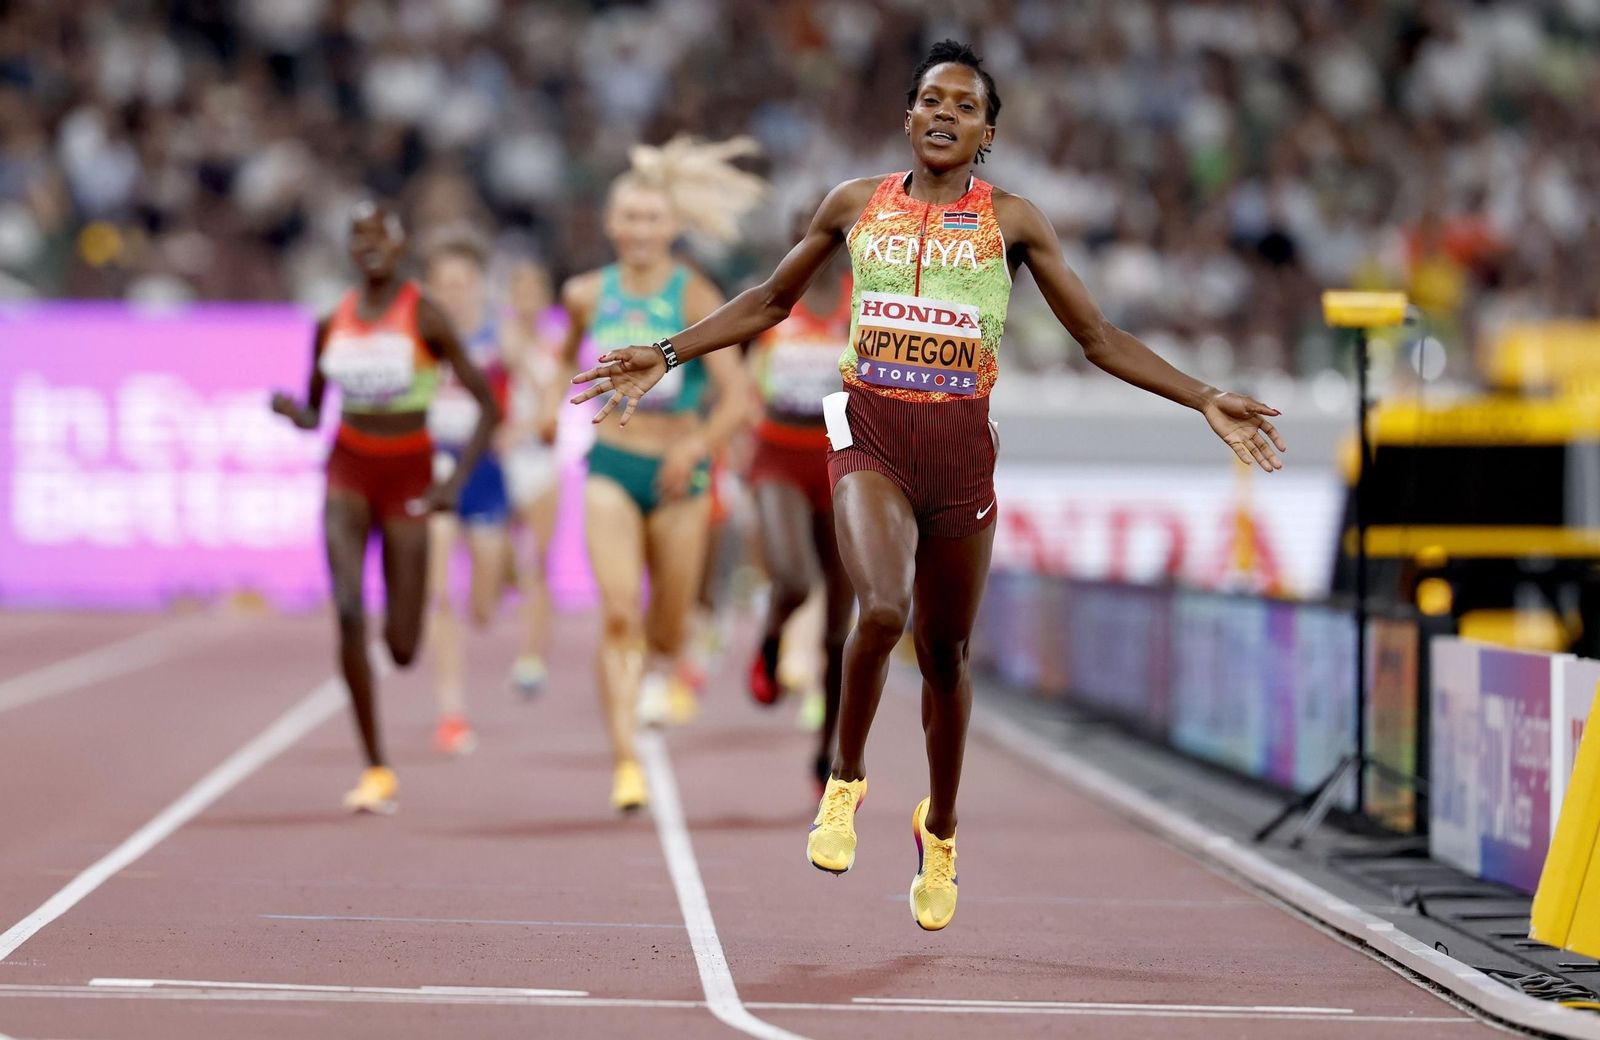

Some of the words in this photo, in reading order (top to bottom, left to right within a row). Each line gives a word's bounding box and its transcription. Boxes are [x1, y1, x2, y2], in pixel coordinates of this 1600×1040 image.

[864, 234, 978, 270] KENYA
[861, 299, 979, 329] HONDA
[858, 329, 976, 368] KIPYEGON
